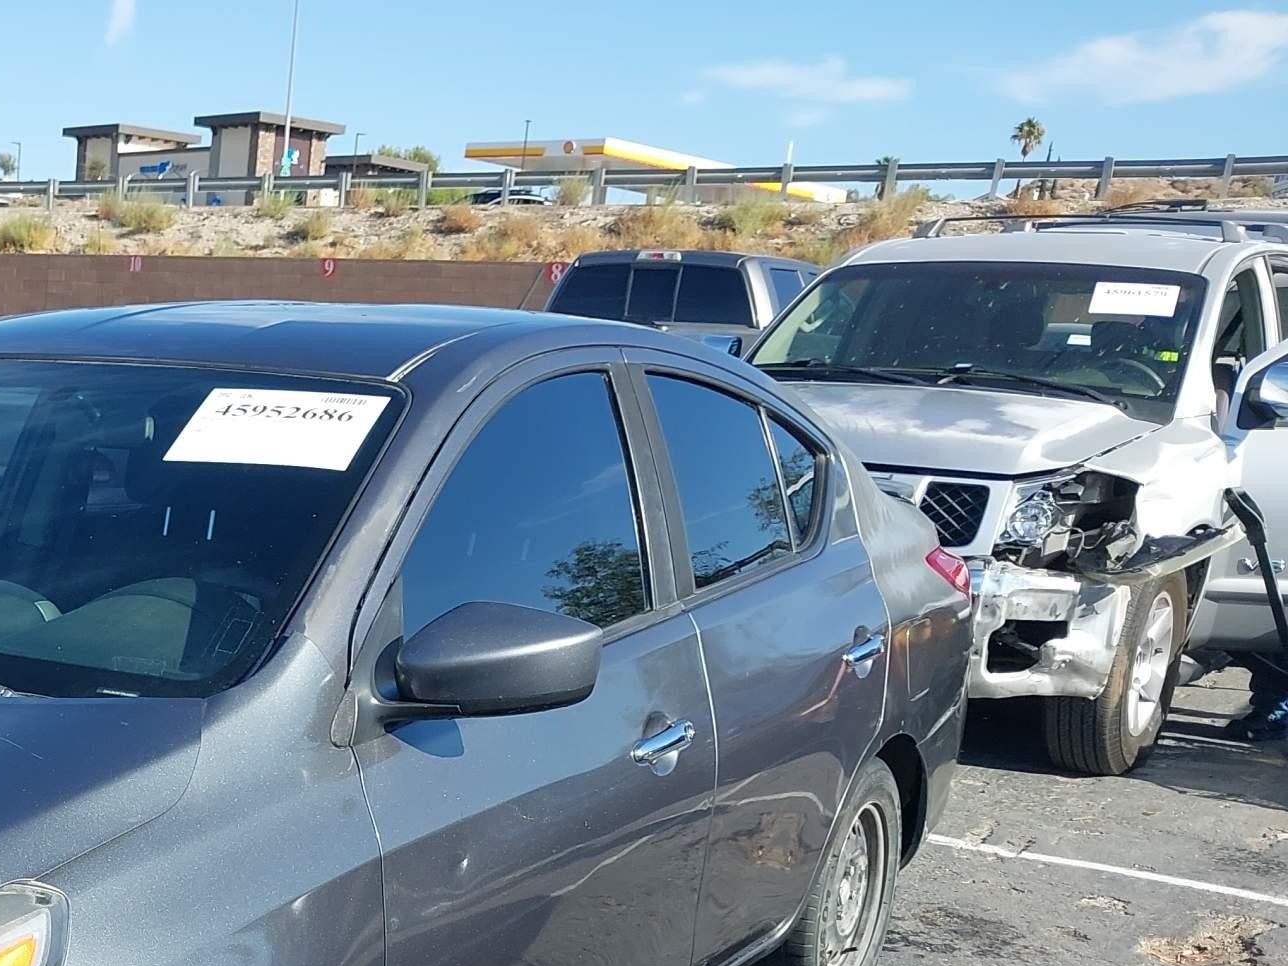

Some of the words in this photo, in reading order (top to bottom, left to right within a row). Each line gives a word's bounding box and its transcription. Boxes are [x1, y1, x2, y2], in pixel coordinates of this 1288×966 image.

[129, 256, 142, 272] 10
[324, 260, 334, 276] 9
[551, 263, 562, 284] 8
[215, 403, 354, 423] 45952686
